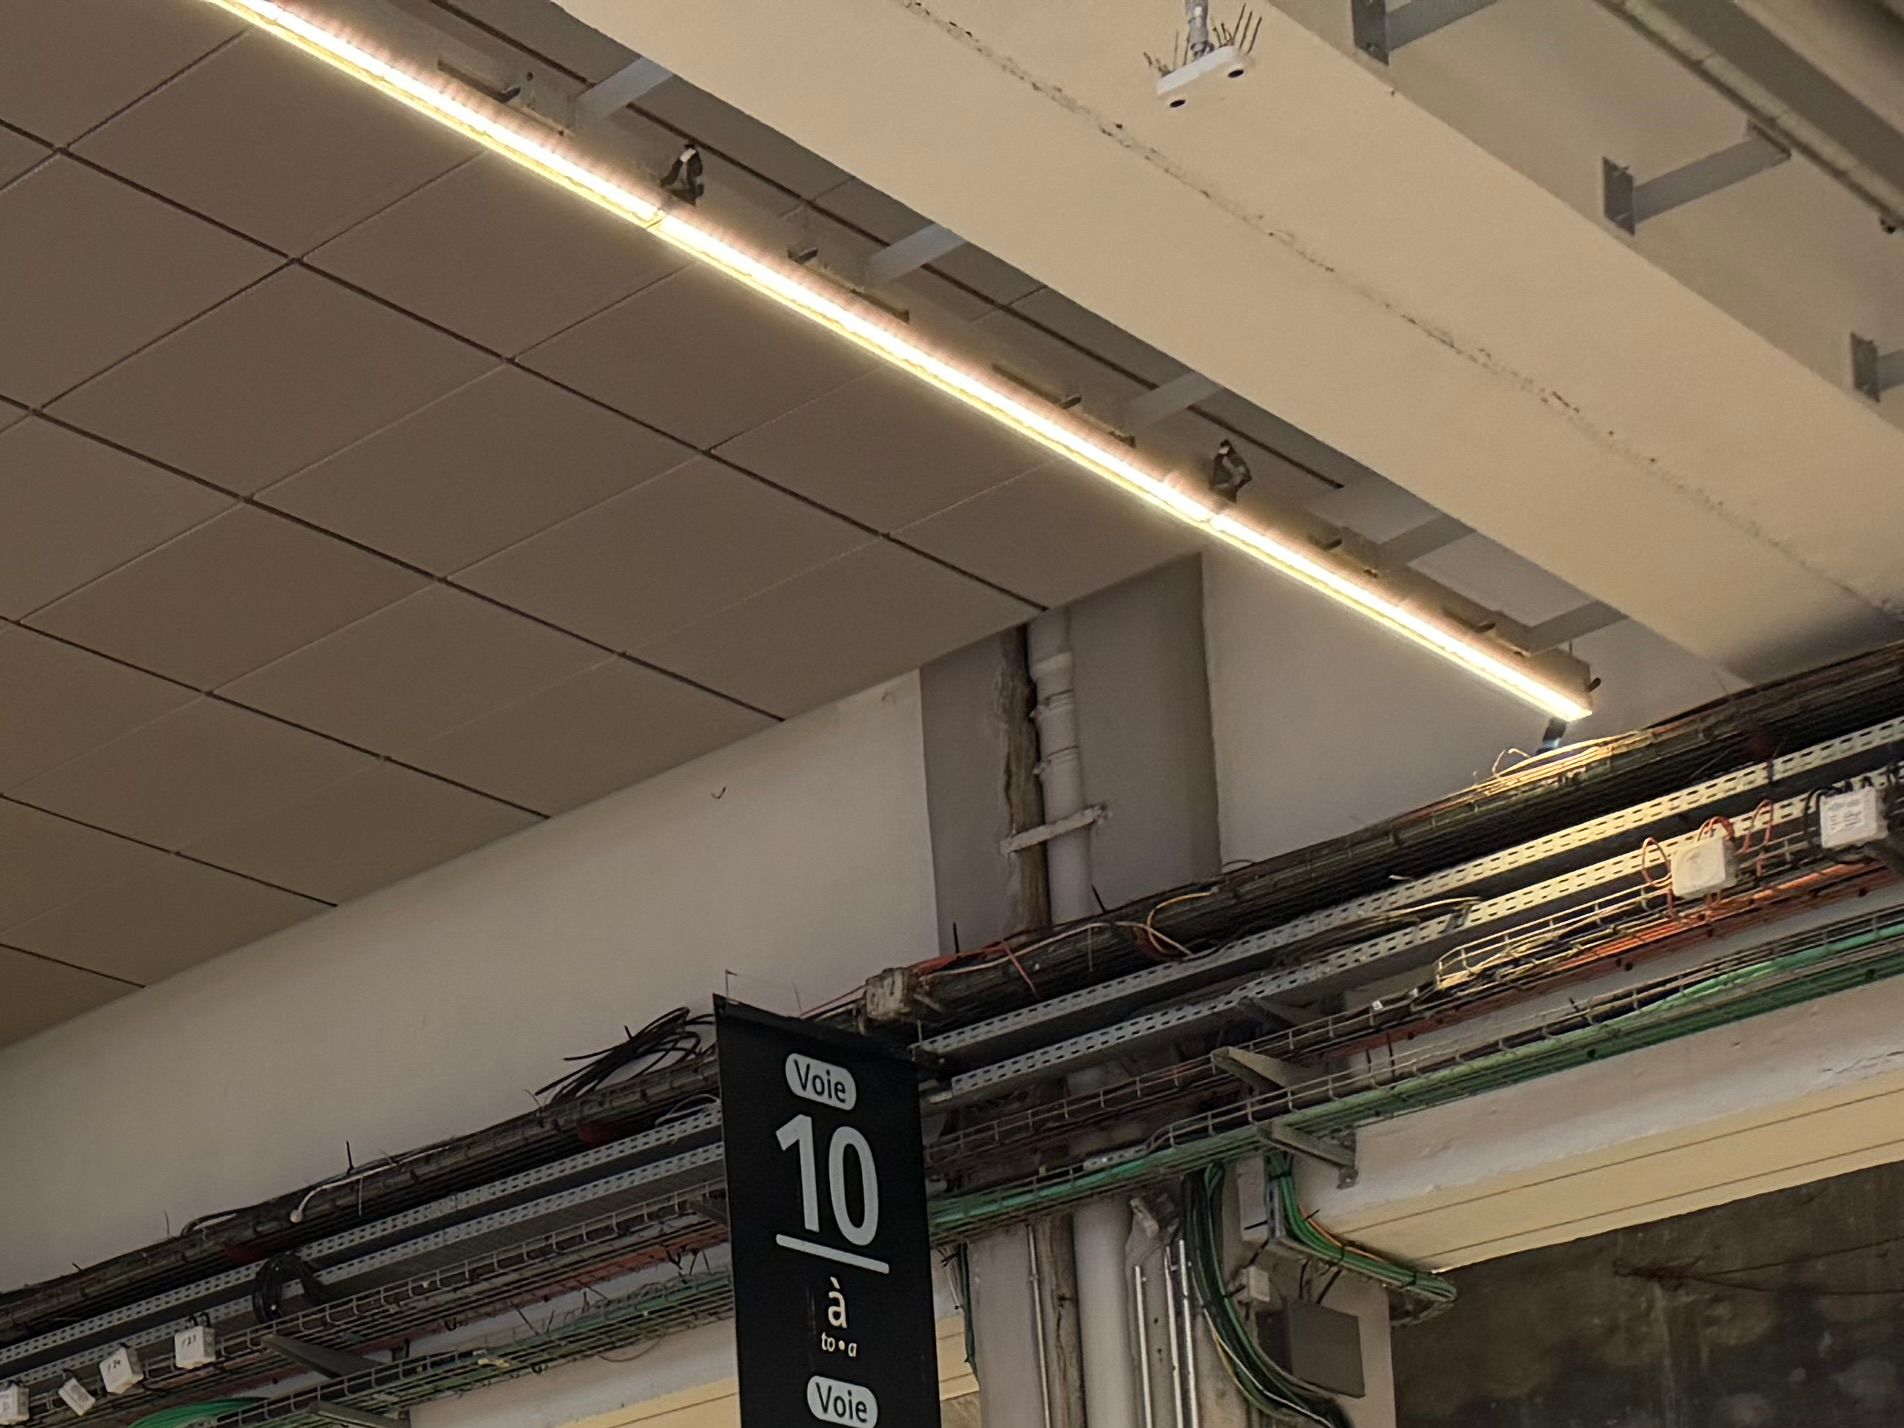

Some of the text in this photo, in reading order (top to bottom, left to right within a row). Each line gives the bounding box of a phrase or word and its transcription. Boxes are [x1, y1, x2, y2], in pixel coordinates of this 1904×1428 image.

[794, 1058, 848, 1105] Voie
[775, 1113, 880, 1248] 10
[827, 1277, 849, 1330] à
[815, 1380, 869, 1425] Voie
